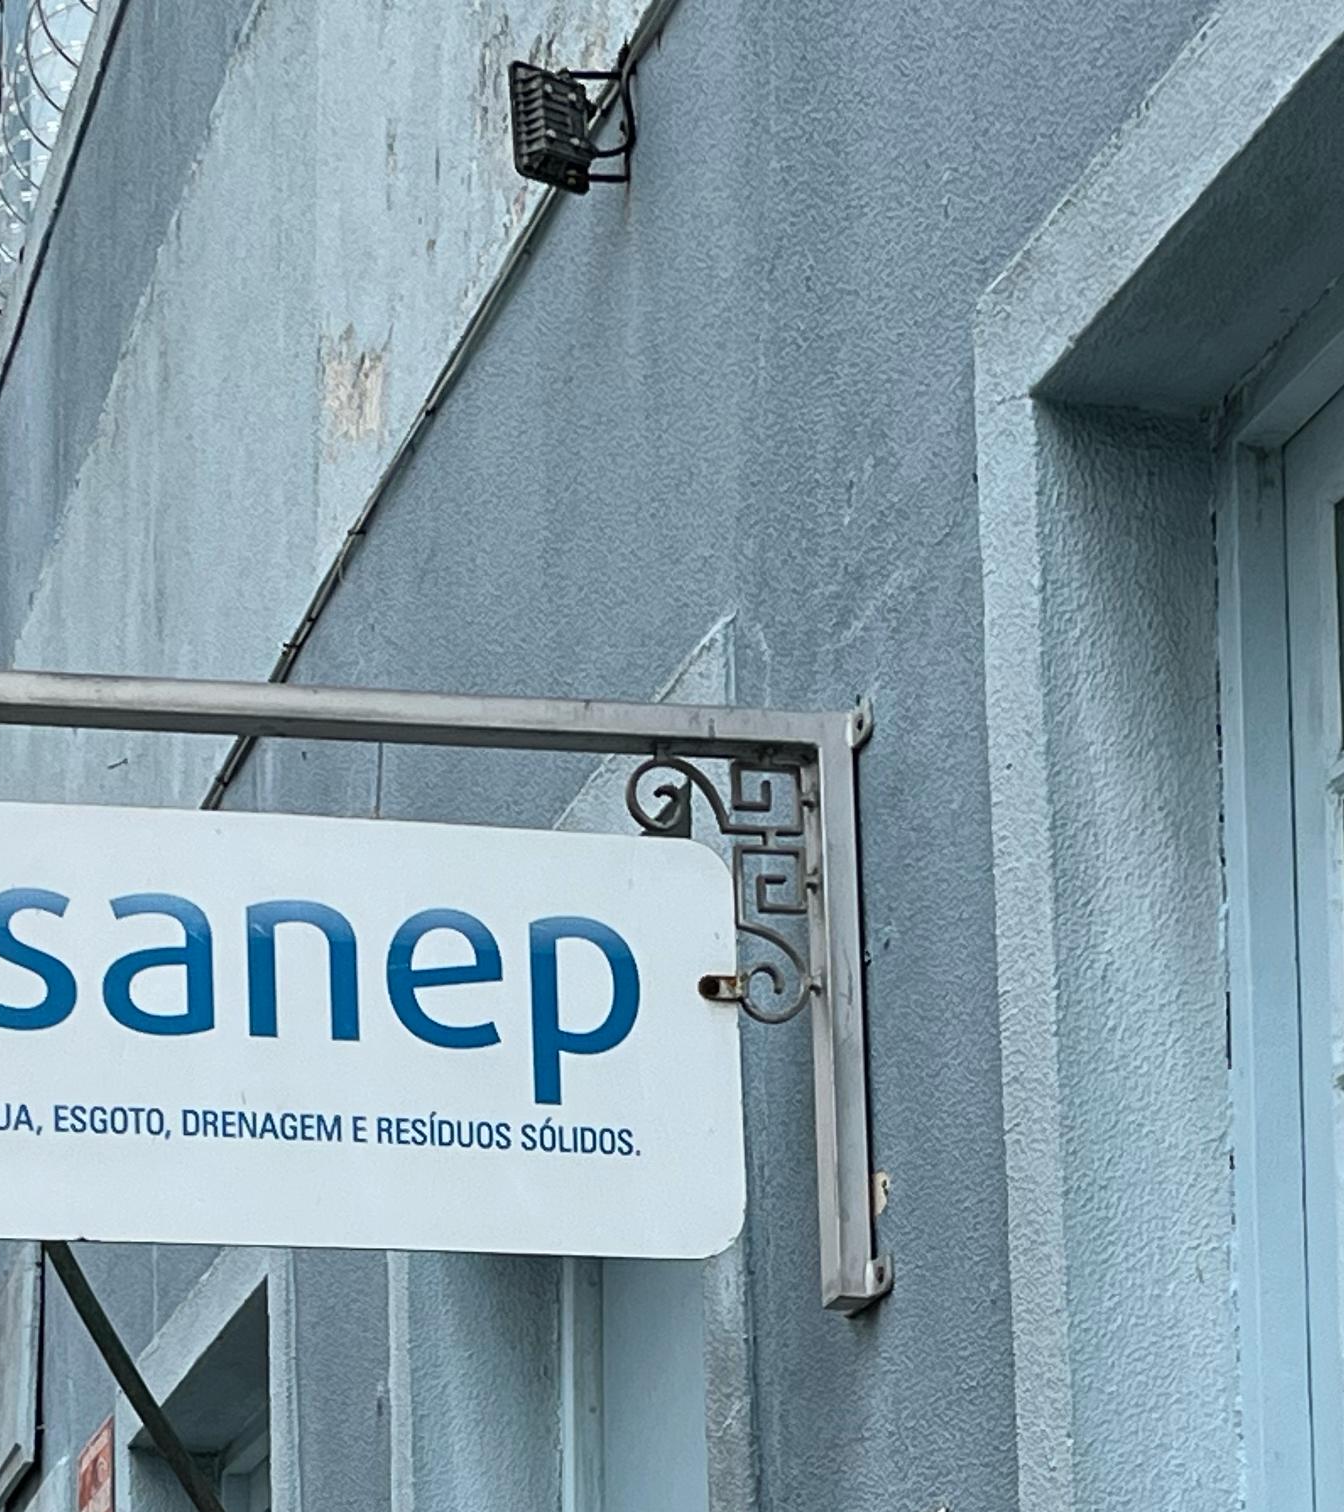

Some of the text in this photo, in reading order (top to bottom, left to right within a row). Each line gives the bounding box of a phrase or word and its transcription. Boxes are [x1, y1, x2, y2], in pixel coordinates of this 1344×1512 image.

[53, 1104, 171, 1140] ESGOTO,
[181, 1109, 342, 1143] DRENAGEM
[352, 1115, 368, 1143] E
[376, 1111, 512, 1150] RESÍDUOS
[520, 1116, 641, 1157] SÓLIDOS.
